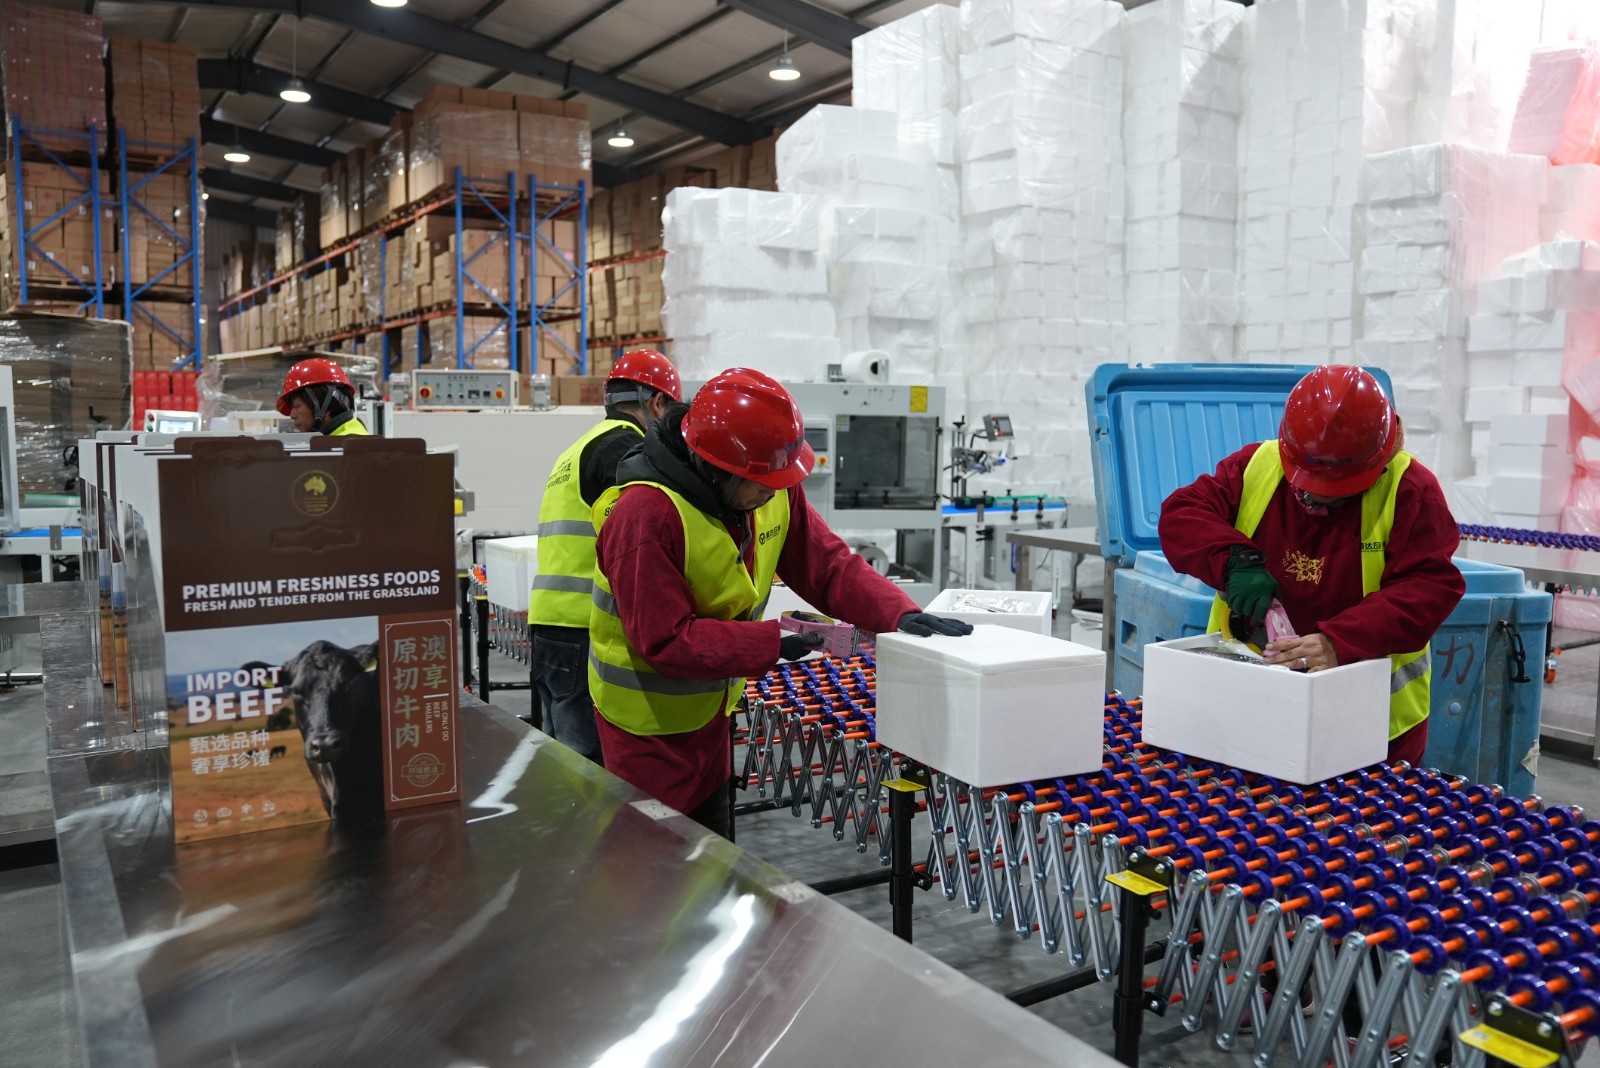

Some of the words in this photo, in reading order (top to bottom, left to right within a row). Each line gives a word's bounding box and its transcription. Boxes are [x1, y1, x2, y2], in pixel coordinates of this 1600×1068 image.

[182, 579, 272, 600] PREMIUM
[277, 573, 380, 594] FRESHNESS
[383, 569, 441, 587] FOODS
[184, 600, 227, 613] FRESH
[229, 597, 256, 610] AND
[260, 594, 308, 608] TENDER
[310, 592, 345, 604] FROM
[346, 590, 371, 601] THE
[372, 585, 440, 600] GRASSLAND
[420, 634, 449, 690] 澳享
[186, 666, 283, 693] IMPORT
[187, 687, 285, 724] BEEF
[392, 637, 421, 750] 原切牛肉
[441, 700, 449, 711] WE
[425, 702, 433, 734] HAULERS
[433, 701, 441, 719] BEEF
[189, 728, 270, 754] 甄选品种
[442, 730, 450, 741] DO
[191, 749, 271, 775] 奢享珍馐
